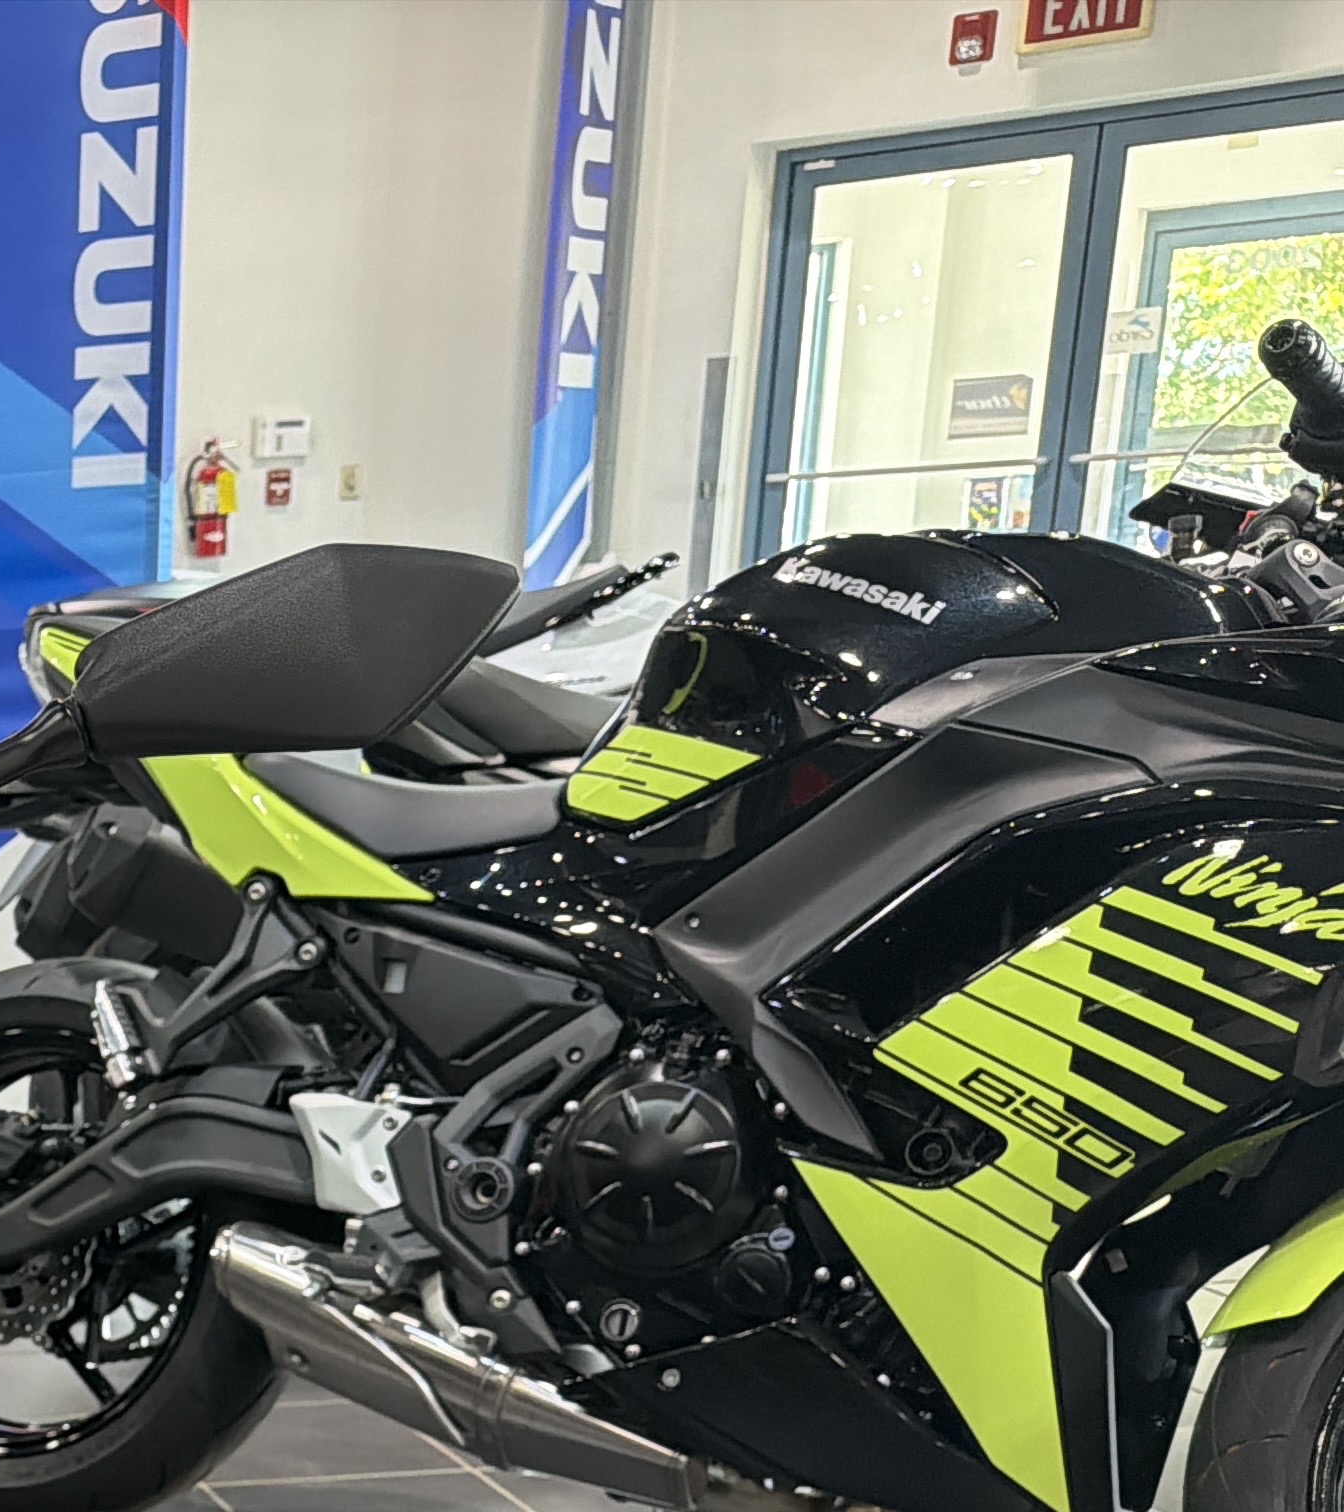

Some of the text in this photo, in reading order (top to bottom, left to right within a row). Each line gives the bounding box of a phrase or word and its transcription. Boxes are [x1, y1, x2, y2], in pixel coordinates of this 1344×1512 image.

[71, 0, 163, 489] UZUKI
[558, 0, 622, 389] ZUKI
[772, 556, 947, 625] Kawasaki
[1162, 838, 1344, 940] Ninja
[957, 1067, 1135, 1179] 650
